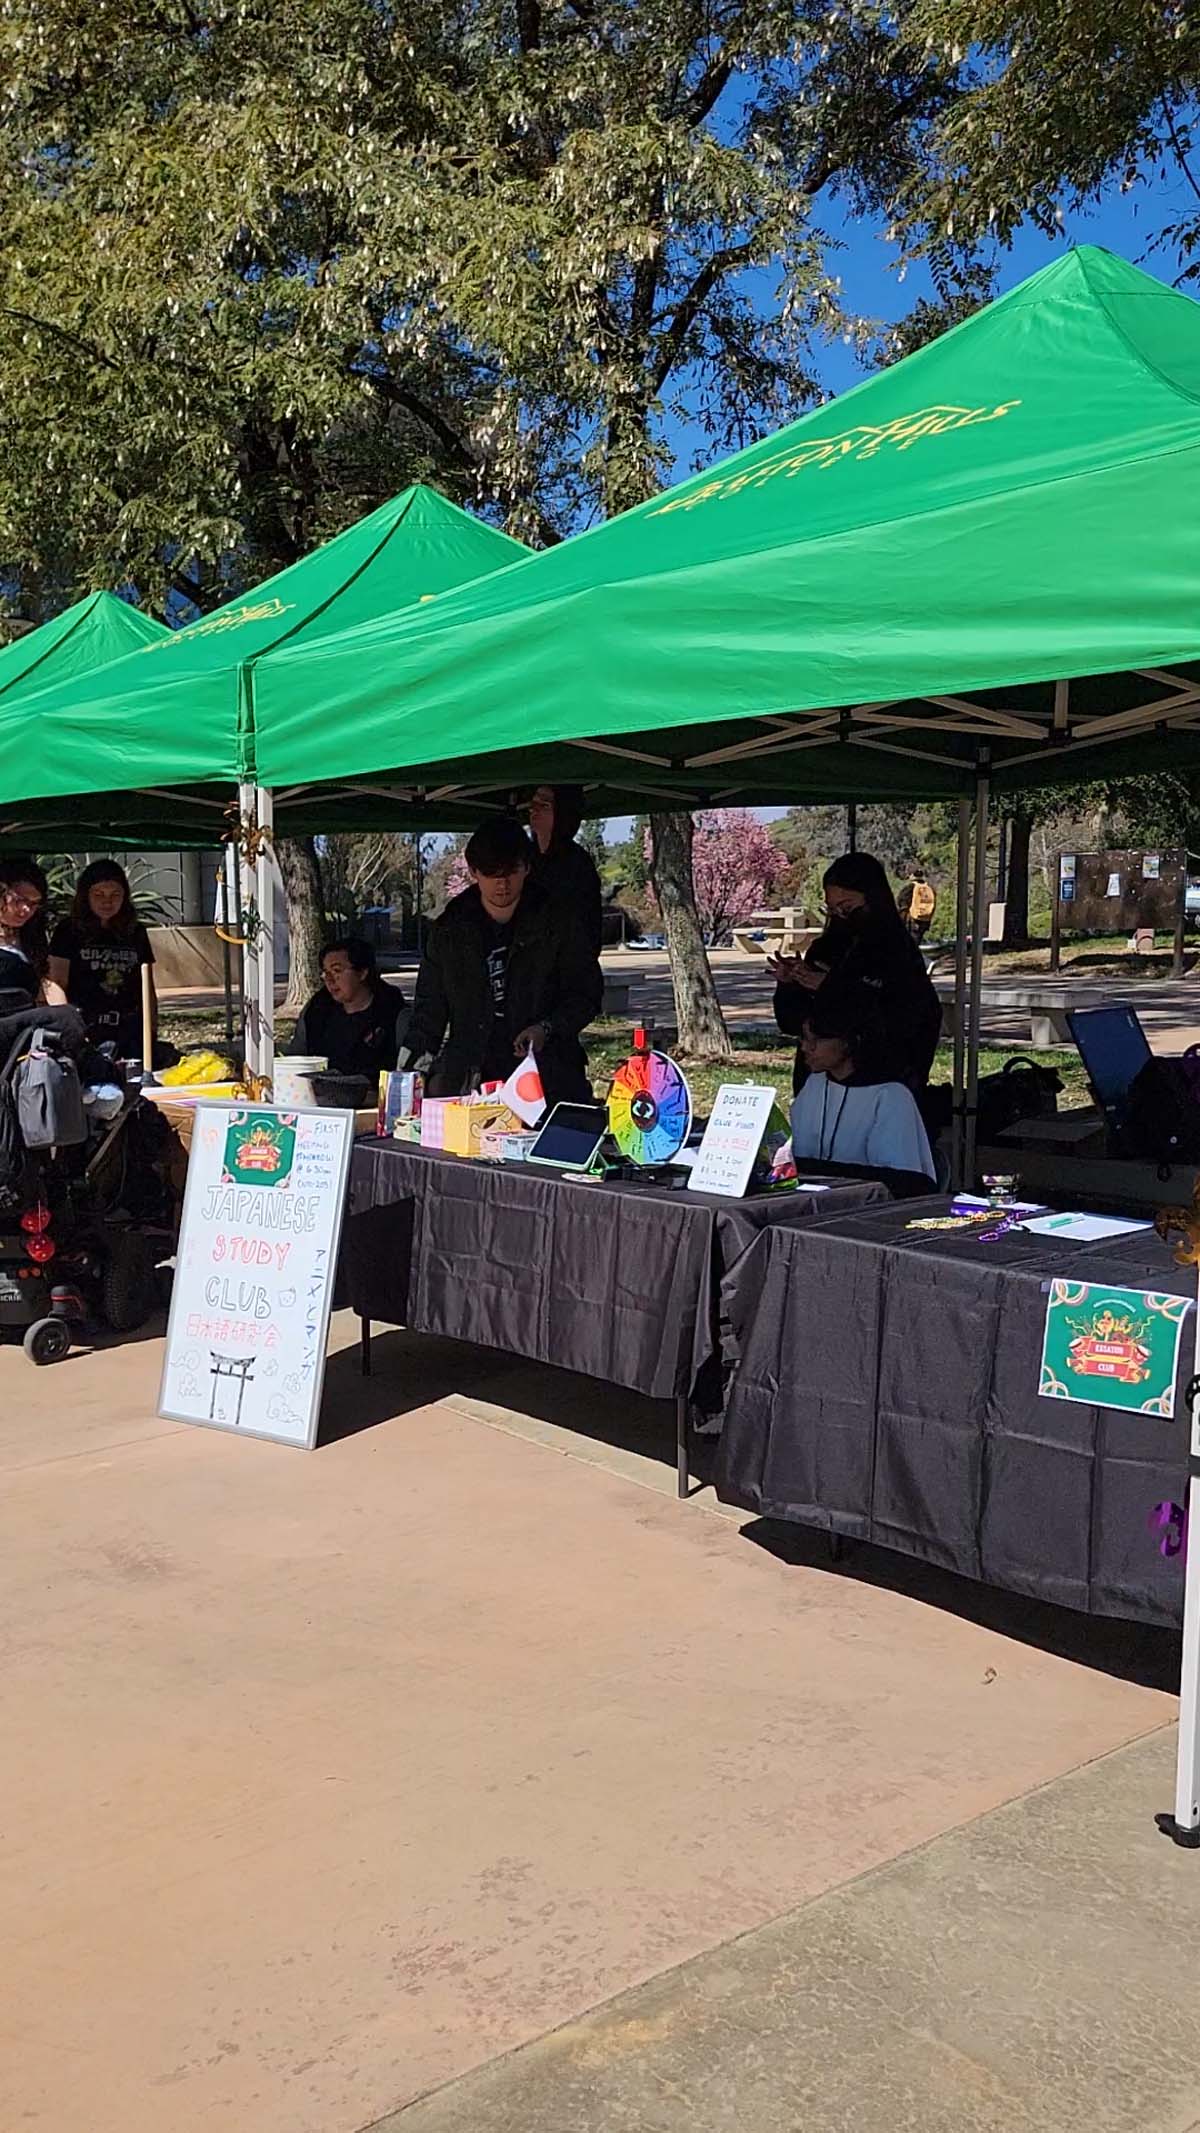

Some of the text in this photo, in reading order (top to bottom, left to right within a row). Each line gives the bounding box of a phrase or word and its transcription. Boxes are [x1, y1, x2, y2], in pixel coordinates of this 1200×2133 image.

[722, 1094, 759, 1107] DONATE
[200, 1184, 321, 1234] JAPANESE
[212, 1234, 291, 1271] STUDY
[204, 1275, 272, 1319] CLUB
